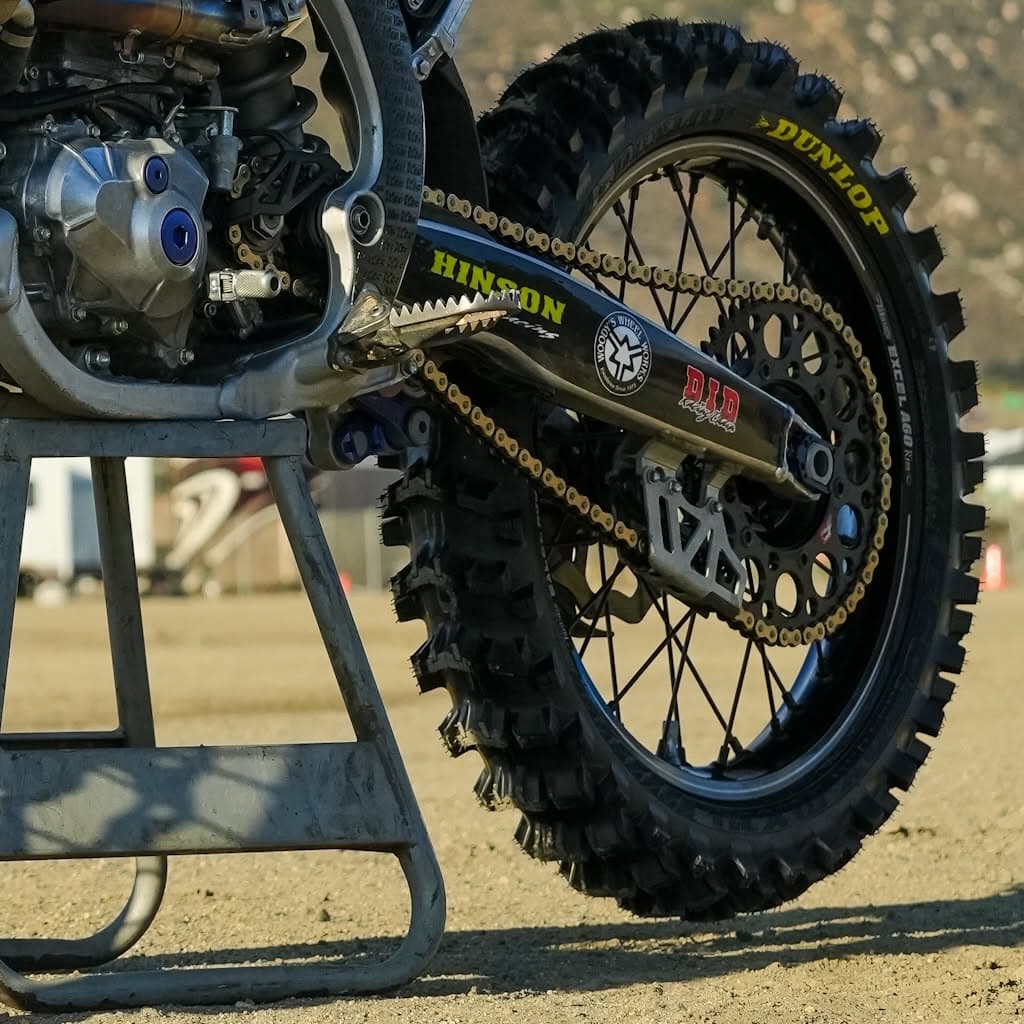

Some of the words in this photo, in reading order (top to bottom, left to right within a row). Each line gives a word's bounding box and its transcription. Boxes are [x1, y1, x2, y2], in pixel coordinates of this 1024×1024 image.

[767, 118, 890, 236] DUNLOP
[617, 315, 643, 340] WHEEL
[637, 341, 650, 383] WORKS
[887, 343, 908, 407] EXCEL
